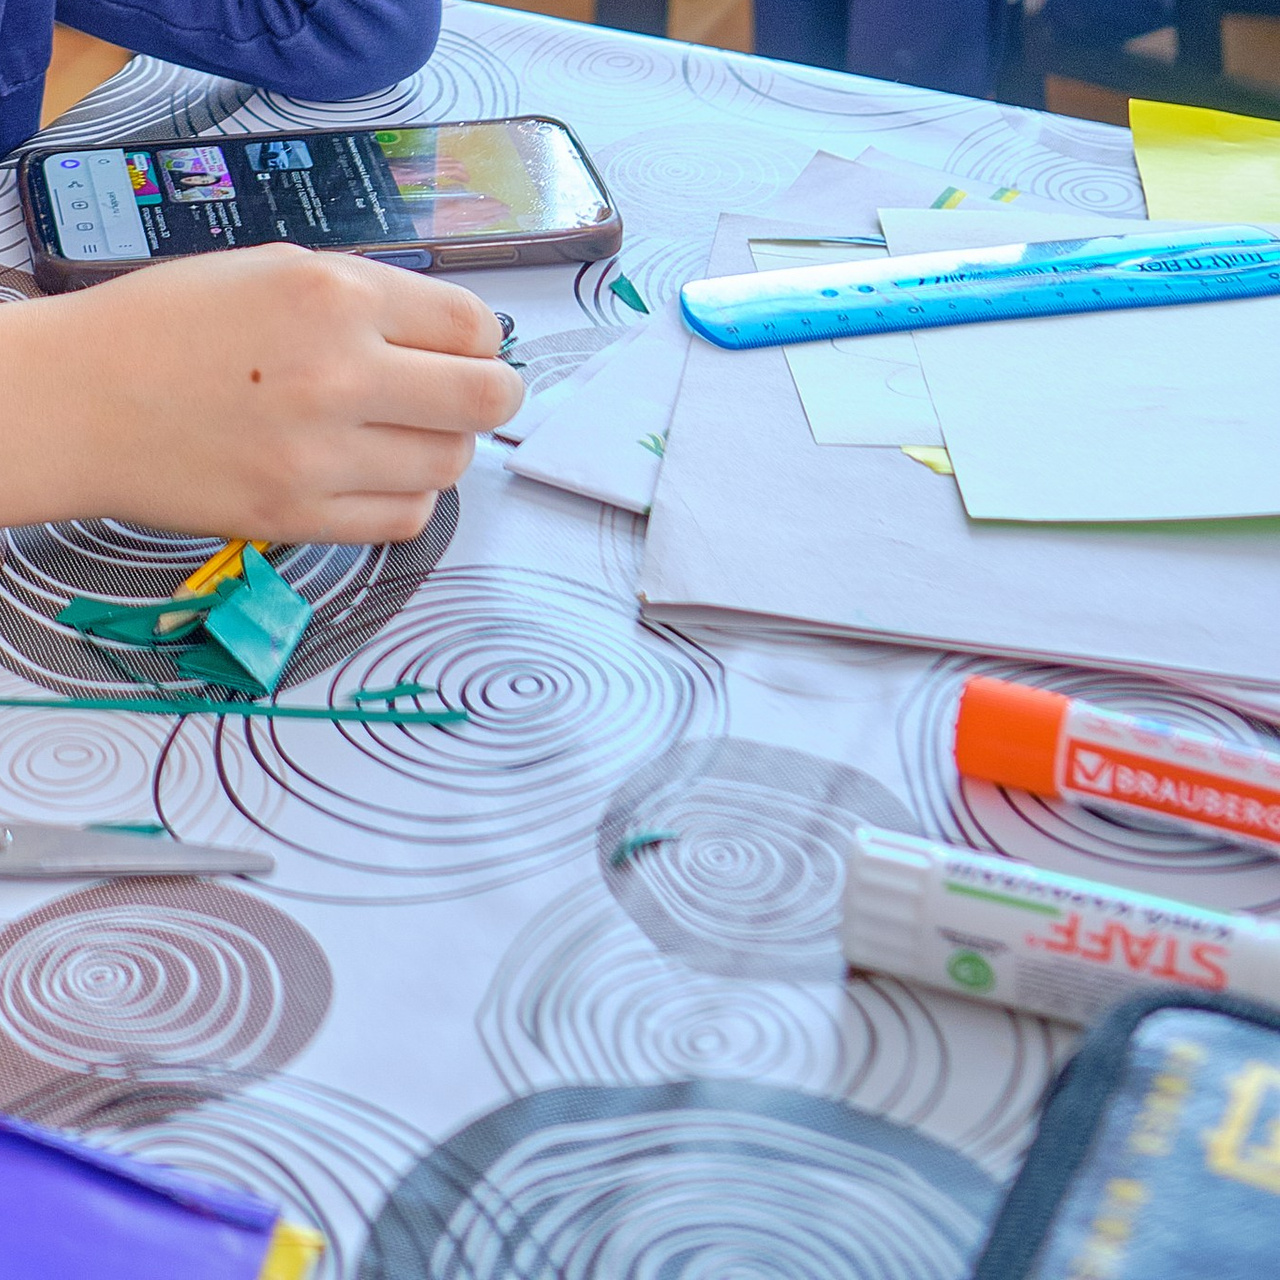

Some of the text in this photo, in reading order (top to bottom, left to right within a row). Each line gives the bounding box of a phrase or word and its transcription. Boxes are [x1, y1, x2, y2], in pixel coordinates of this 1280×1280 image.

[1136, 258, 1181, 273] Flex
[908, 305, 925, 315] 10
[1042, 912, 1232, 994] STAFF
